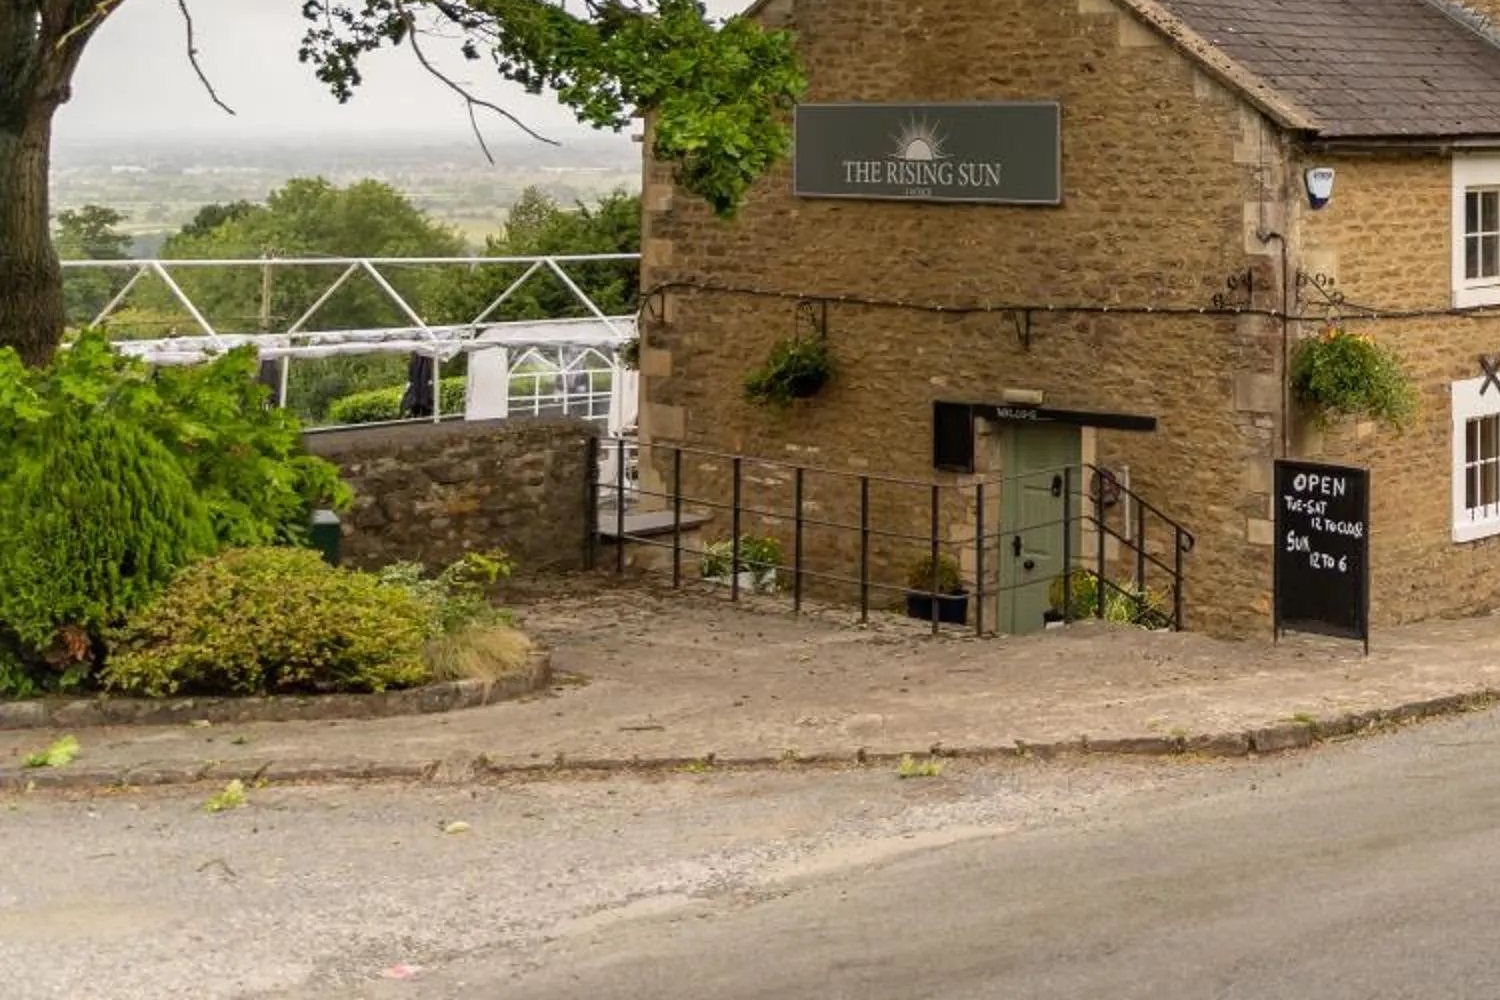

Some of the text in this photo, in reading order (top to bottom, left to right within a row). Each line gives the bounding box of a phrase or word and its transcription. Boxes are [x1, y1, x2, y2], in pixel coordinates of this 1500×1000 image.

[843, 160, 1001, 187] THE RISING SUN
[1293, 473, 1346, 497] OPEN
[1311, 517, 1322, 531] 12
[1325, 518, 1337, 532] TO
[1321, 553, 1335, 569] TO
[1338, 555, 1348, 572] 6
